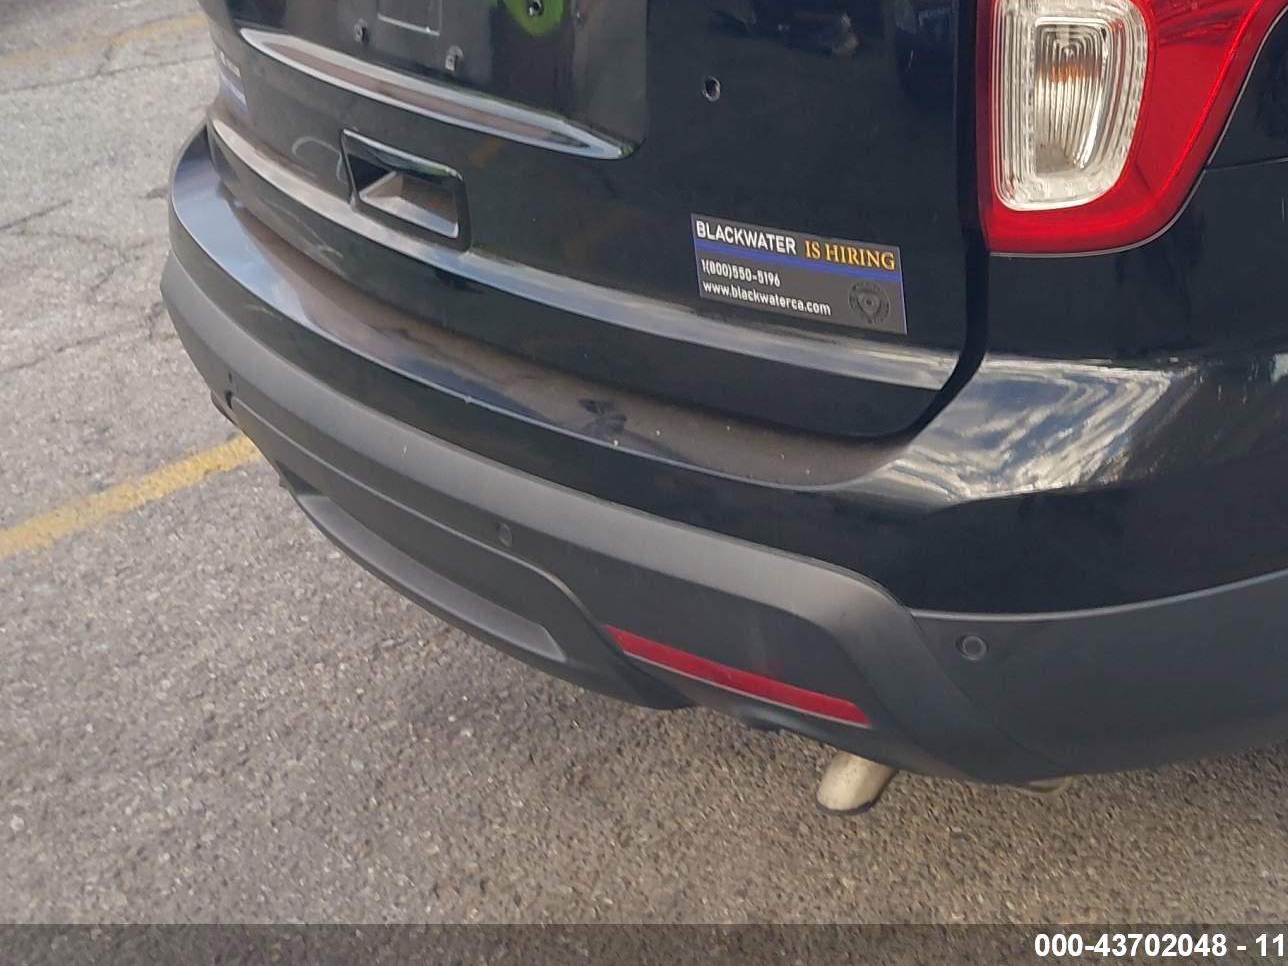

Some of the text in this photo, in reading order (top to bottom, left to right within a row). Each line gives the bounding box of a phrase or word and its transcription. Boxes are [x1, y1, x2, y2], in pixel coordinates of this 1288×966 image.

[695, 219, 896, 271] BLACKWATER IS HIRING
[701, 258, 781, 288] 1(800)550-5196
[702, 280, 832, 317] www.blackwaterca.com
